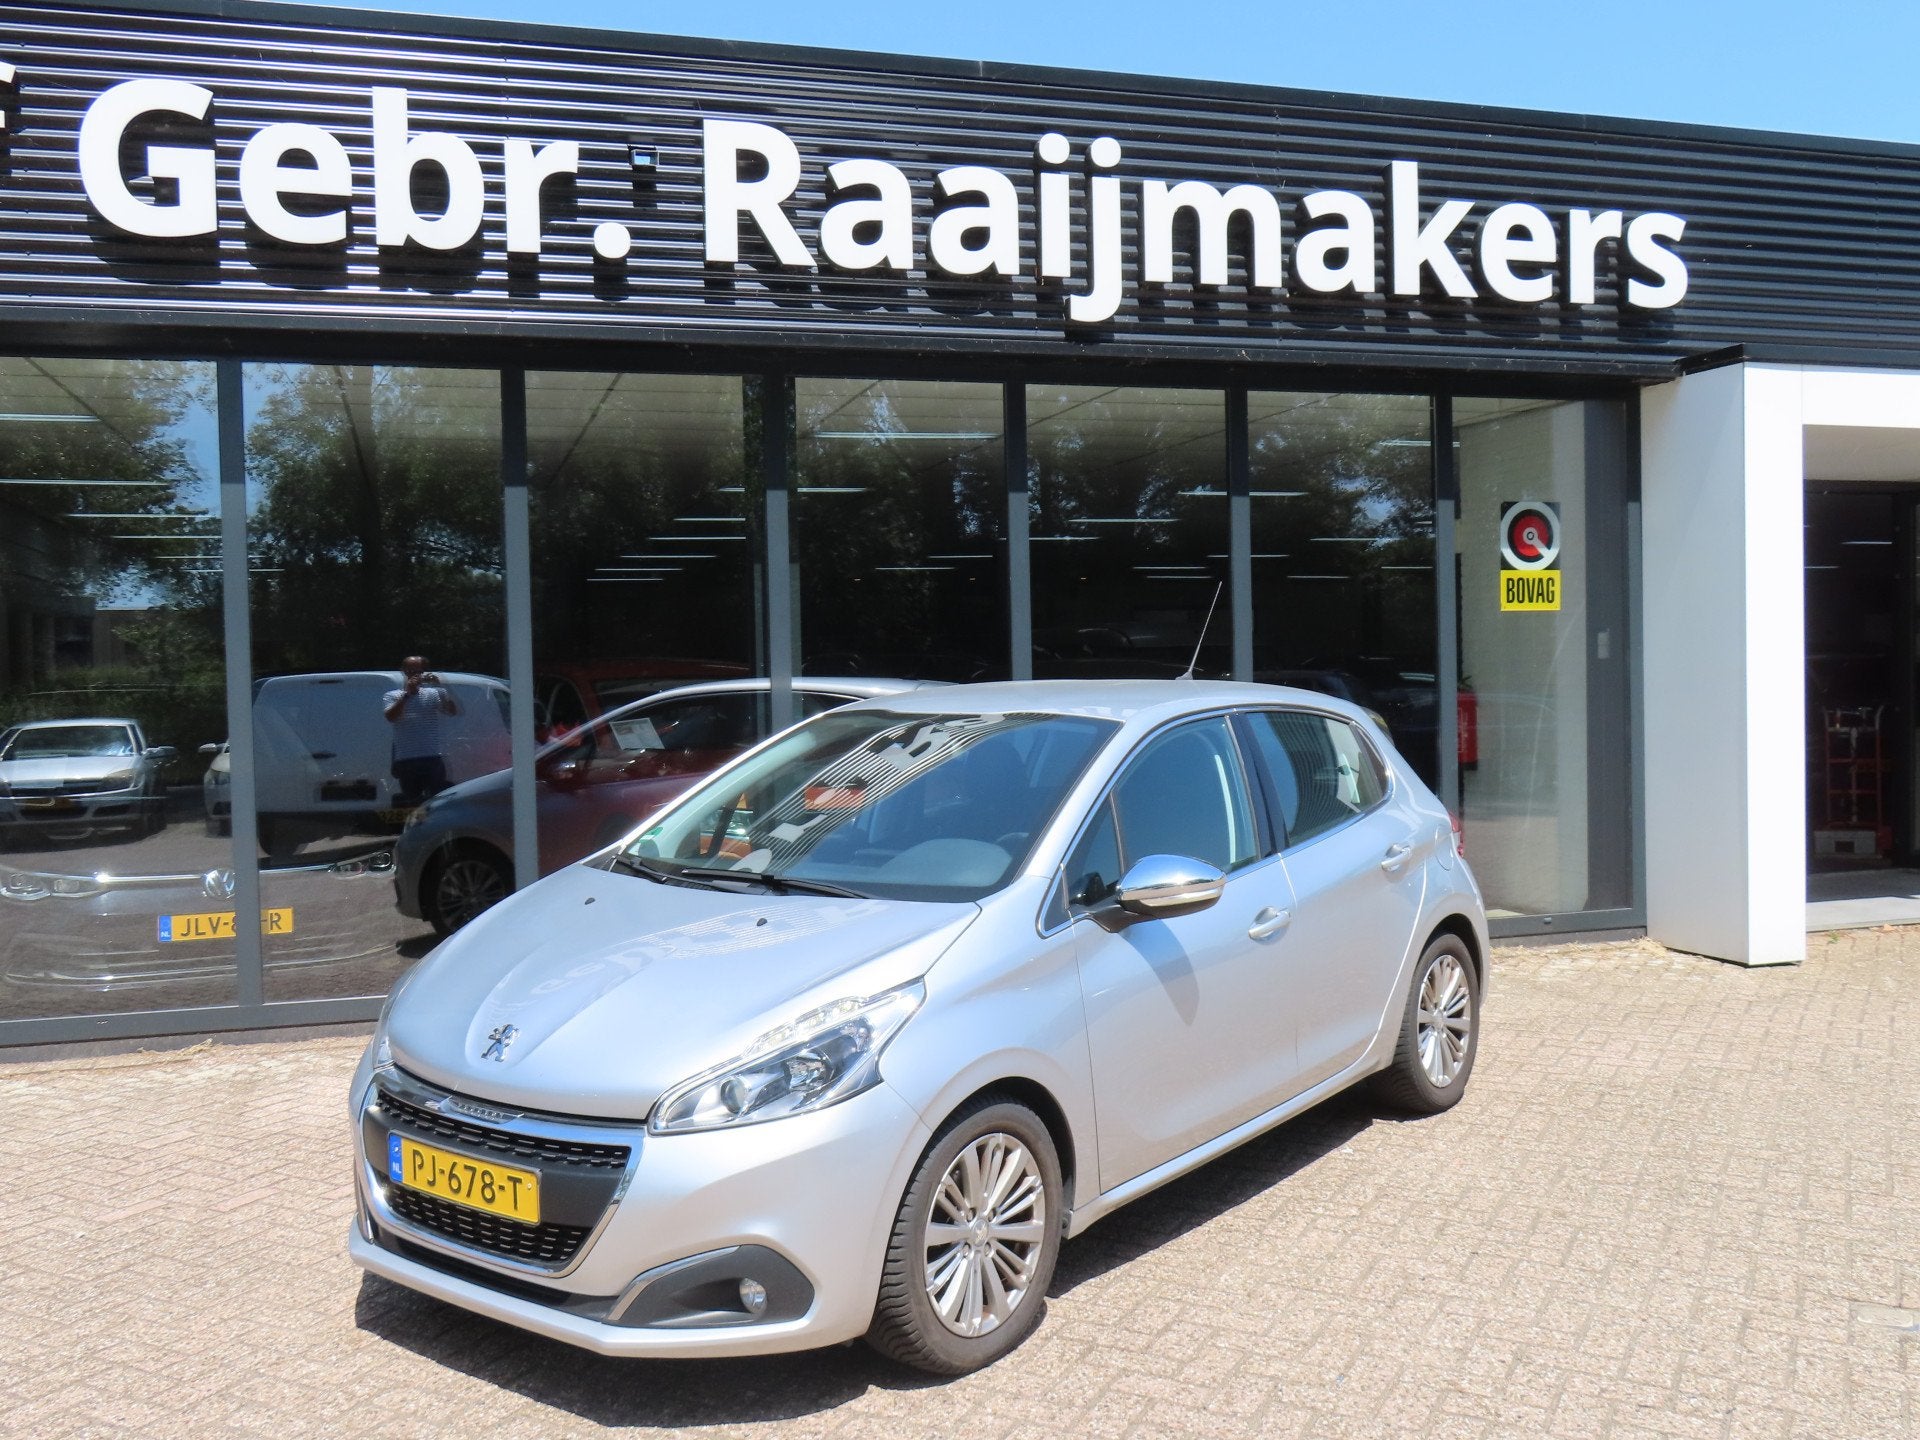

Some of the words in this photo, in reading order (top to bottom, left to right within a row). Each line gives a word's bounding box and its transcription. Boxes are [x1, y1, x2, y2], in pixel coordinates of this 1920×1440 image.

[78, 78, 631, 260] Gebr.
[702, 118, 1689, 323] Raaijmakers
[1506, 577, 1555, 604] BOVAG
[392, 1161, 402, 1174] NL
[412, 1149, 523, 1210] PJ-678-T
